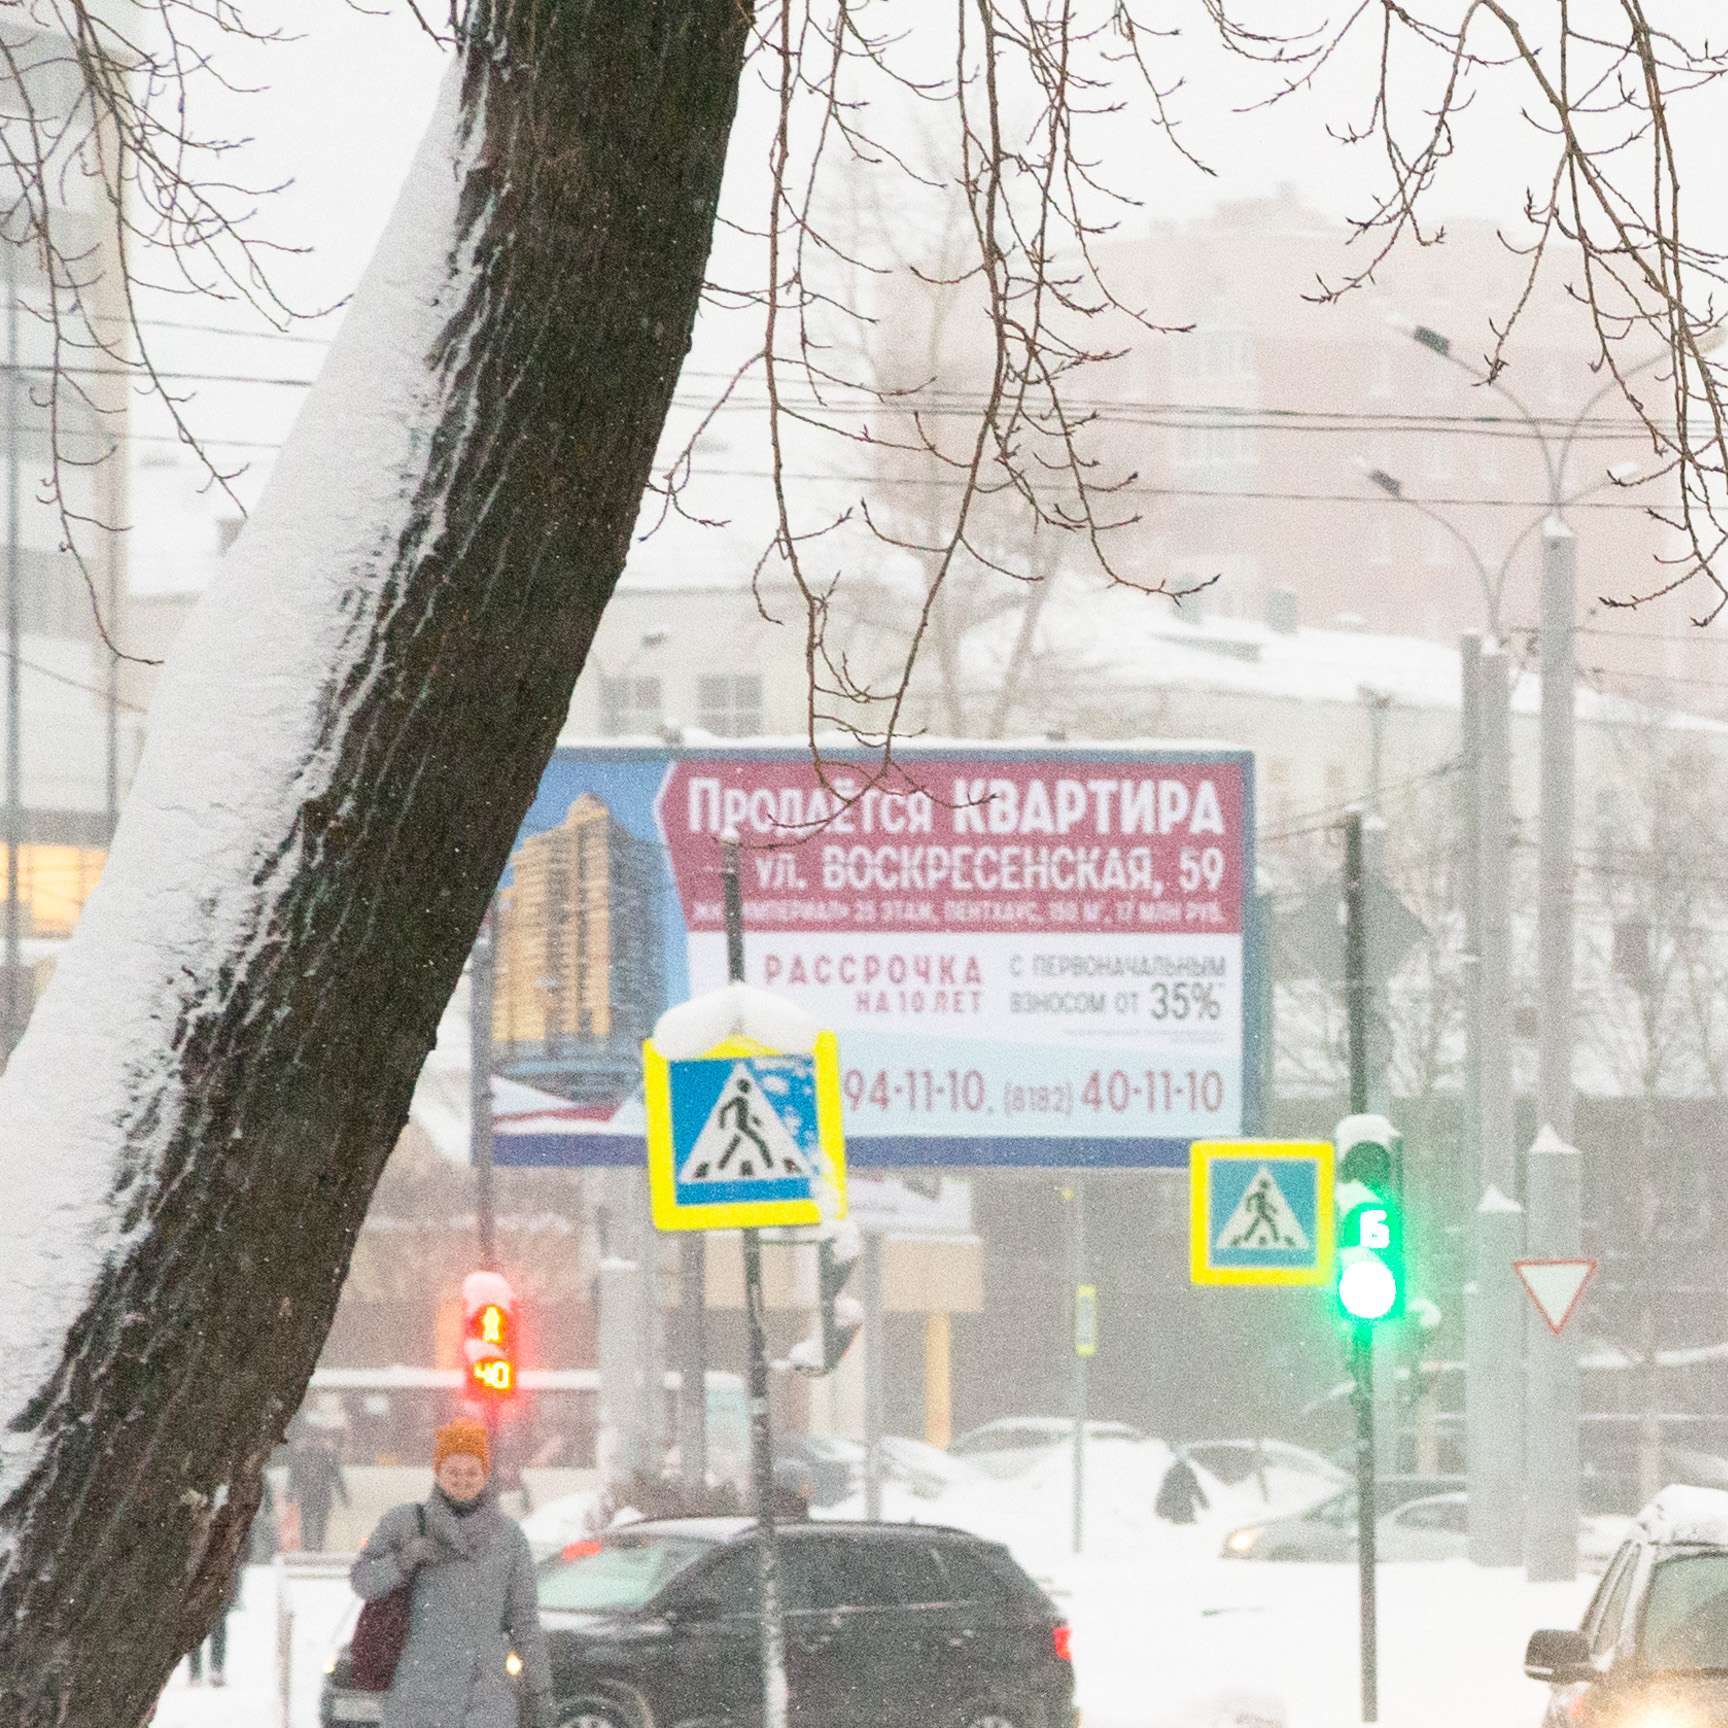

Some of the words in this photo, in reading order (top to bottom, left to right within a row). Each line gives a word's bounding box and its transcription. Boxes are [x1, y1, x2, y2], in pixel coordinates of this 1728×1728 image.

[953, 778, 1225, 835] КВАРТИРА
[822, 846, 1164, 897] ВОСКРЕСЕНСКАЯ,
[1179, 847, 1223, 891] 59
[765, 953, 982, 984] РАССРОЧКА
[1010, 954, 1023, 978] С
[1033, 954, 1226, 977] ПЕРВОНАЧАЛЬНЫМ
[856, 990, 890, 1012] НА
[899, 990, 925, 1012] 10
[935, 990, 981, 1012] ЛЕТ
[1010, 991, 1105, 1014] ВЗНОСОМ
[1114, 992, 1139, 1014] ОТ
[473, 1361, 511, 1389] 40
